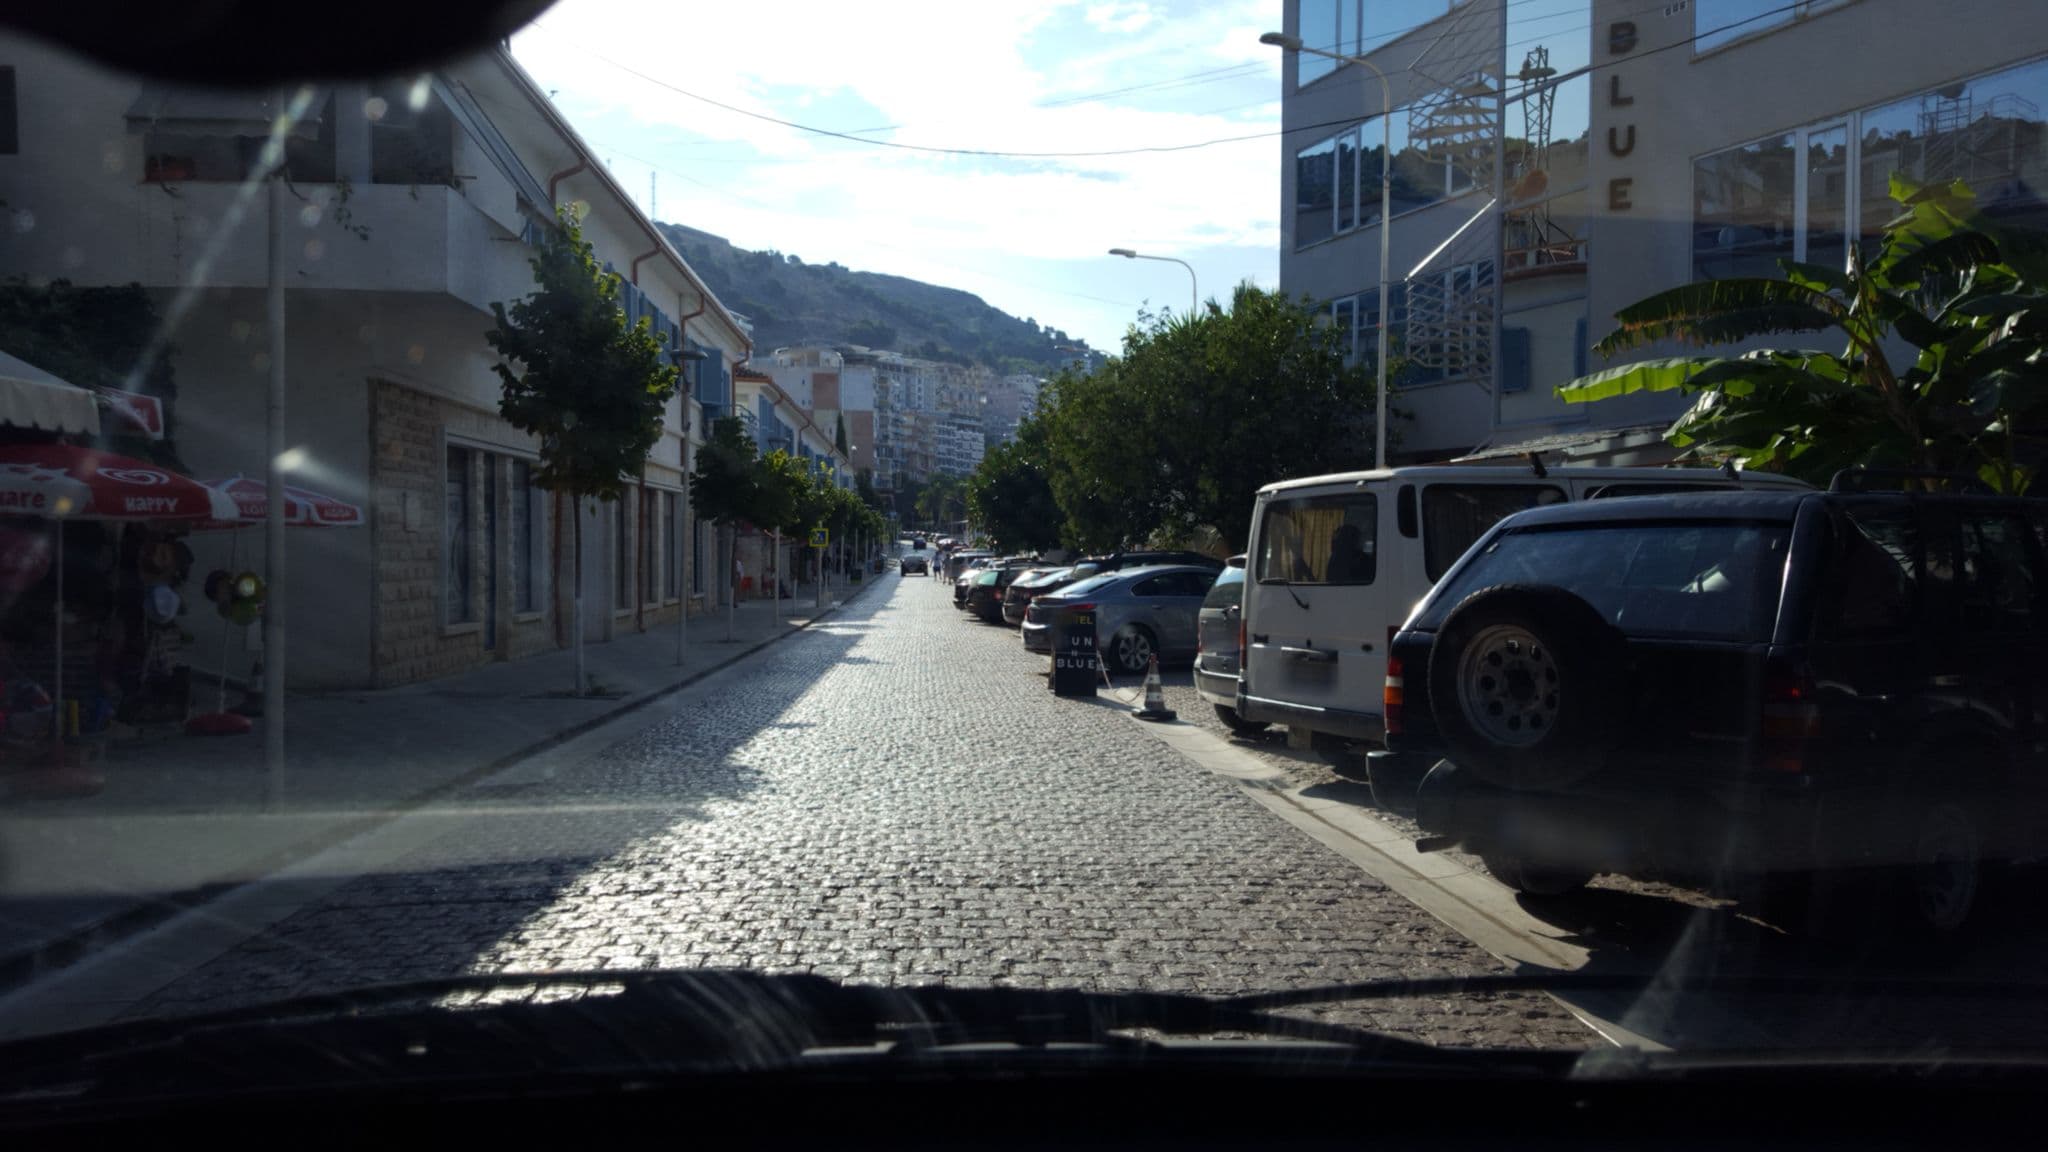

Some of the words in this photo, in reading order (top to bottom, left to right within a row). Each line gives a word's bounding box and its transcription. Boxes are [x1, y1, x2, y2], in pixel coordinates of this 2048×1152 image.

[1609, 22, 1636, 211] BLUE
[1064, 636, 1093, 647] UN
[1056, 658, 1095, 669] BLUE
